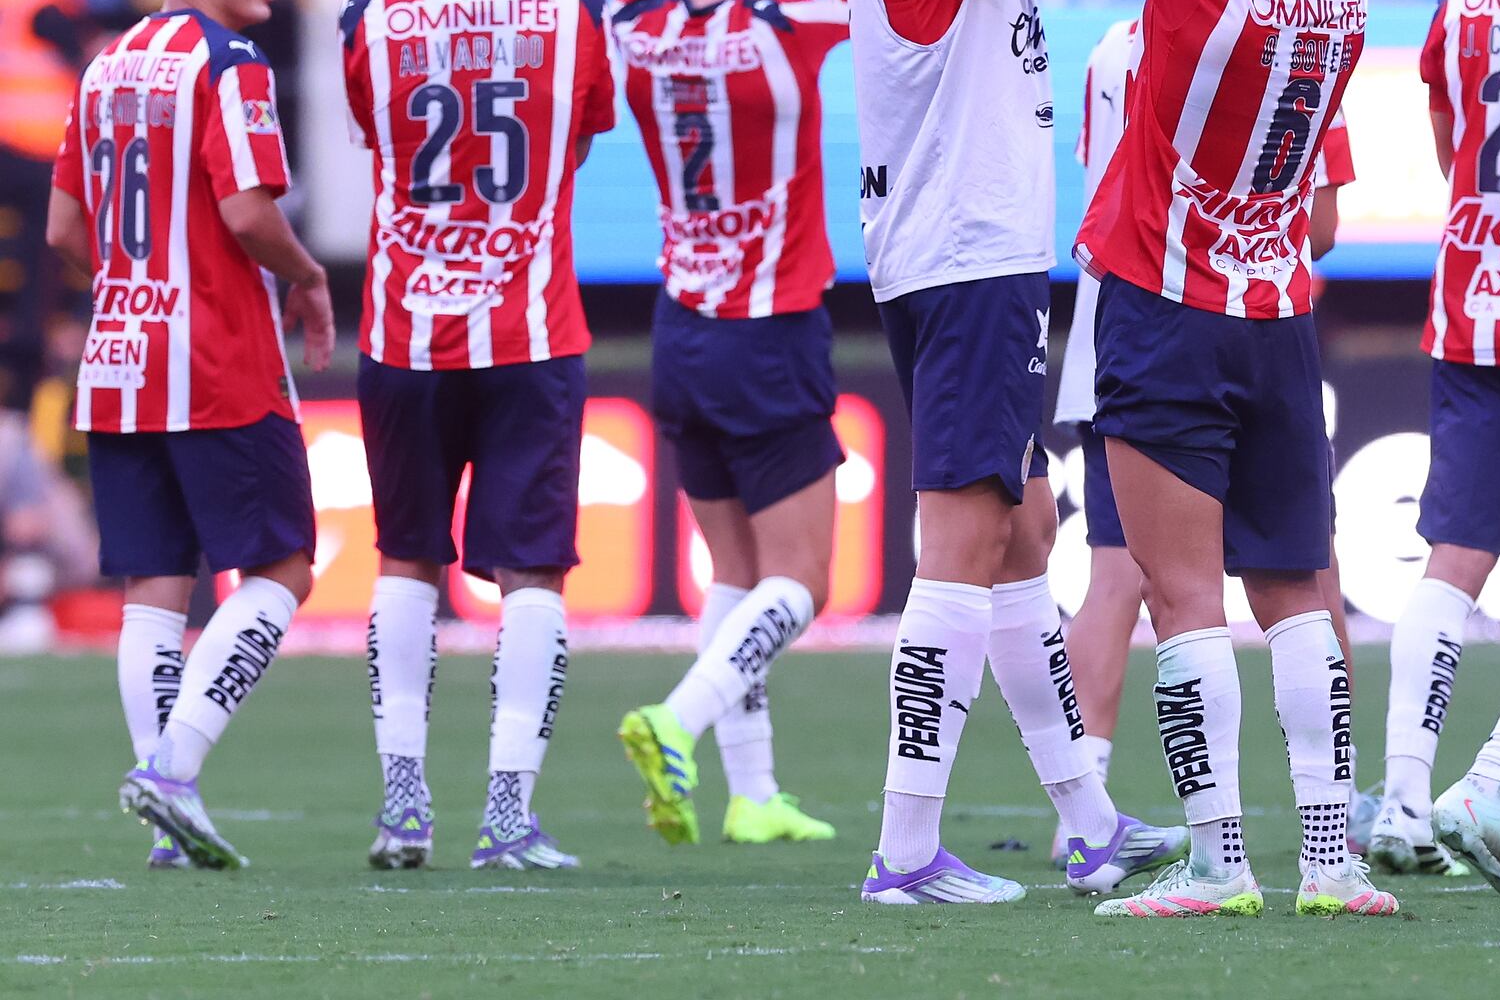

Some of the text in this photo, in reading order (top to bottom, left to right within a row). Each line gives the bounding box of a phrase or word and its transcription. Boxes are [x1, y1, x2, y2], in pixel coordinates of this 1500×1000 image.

[387, 0, 550, 34] OMNILIFE
[400, 34, 545, 77] ALVARADO
[1463, 23, 1482, 58] J.
[407, 78, 529, 205] 25
[674, 112, 720, 213] 2
[1252, 78, 1322, 194] 6
[90, 137, 151, 261] 26
[382, 211, 549, 258] AKRON
[94, 277, 180, 316] RON
[84, 338, 141, 365] XEN
[204, 614, 284, 715] PERDURA
[894, 645, 948, 762] PERDURA
[1042, 626, 1085, 741] PERDURA
[1422, 634, 1462, 736] PERDURA
[1155, 677, 1217, 799] PERDURA
